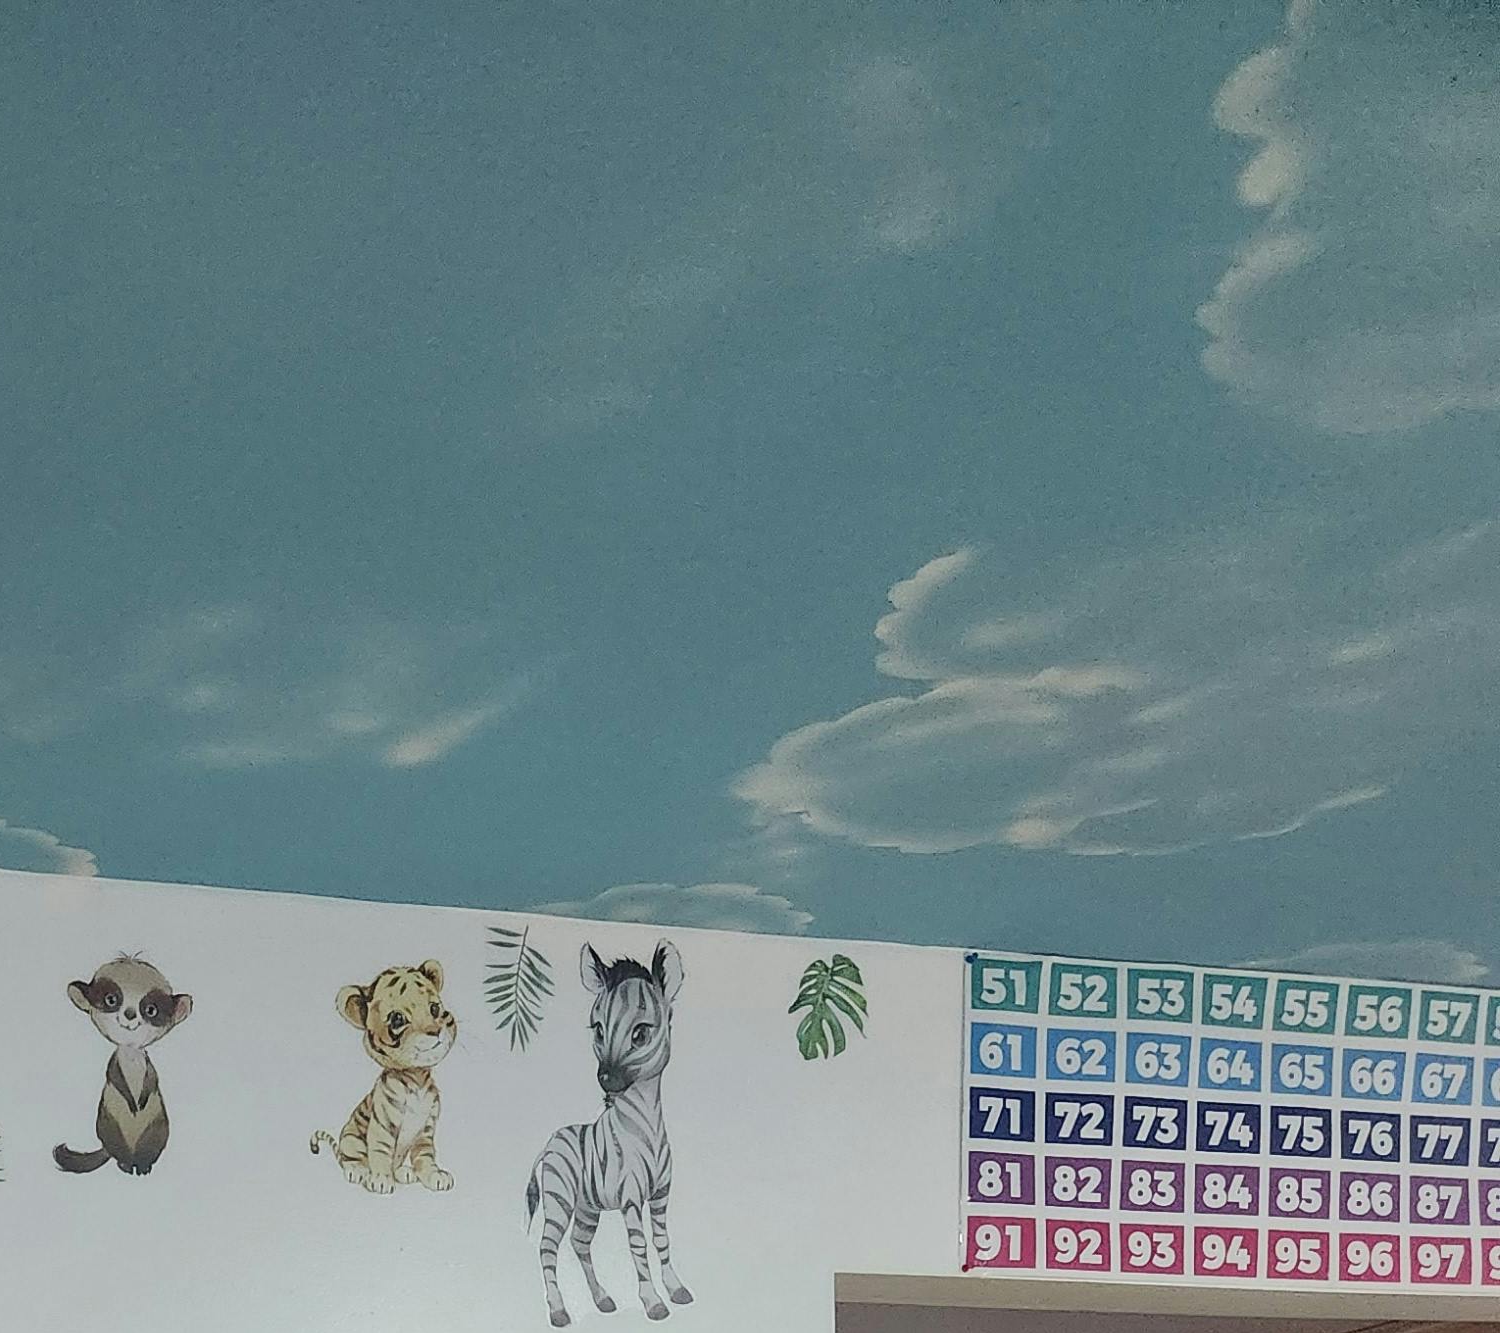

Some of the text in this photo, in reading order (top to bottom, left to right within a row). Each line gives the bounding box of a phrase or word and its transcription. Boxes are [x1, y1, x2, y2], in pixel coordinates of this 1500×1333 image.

[981, 968, 1026, 1005] 51
[1058, 973, 1107, 1011] 52
[1137, 979, 1184, 1015] 53
[1210, 984, 1257, 1022] 54
[1281, 989, 1329, 1027] 55
[1354, 995, 1402, 1032] 56
[1427, 1000, 1472, 1036] 57
[980, 1033, 1022, 1070] 61
[1056, 1039, 1106, 1075] 62
[1136, 1042, 1181, 1079] 63
[1208, 1048, 1254, 1085] 64
[1280, 1053, 1324, 1089] 65
[1350, 1058, 1396, 1094] 66
[1422, 1063, 1466, 1098] 67
[980, 1097, 1020, 1134] 71
[1055, 1102, 1104, 1139] 72
[1133, 1106, 1178, 1143] 73
[1206, 1111, 1253, 1147] 74
[1279, 1115, 1324, 1151] 75
[1349, 1120, 1393, 1155] 76
[1418, 1124, 1463, 1159] 77
[978, 1161, 1020, 1197] 81
[1054, 1166, 1101, 1202] 82
[1129, 1169, 1175, 1206] 83
[1203, 1173, 1252, 1209] 84
[1277, 1177, 1322, 1212] 85
[1347, 1181, 1392, 1216] 86
[1417, 1184, 1462, 1219] 87
[976, 1225, 1021, 1260] 91
[1054, 1228, 1102, 1264] 92
[1128, 1232, 1175, 1267] 93
[1203, 1235, 1250, 1270] 94
[1276, 1238, 1321, 1273] 95
[1347, 1241, 1393, 1276] 96
[1418, 1244, 1464, 1277] 97
